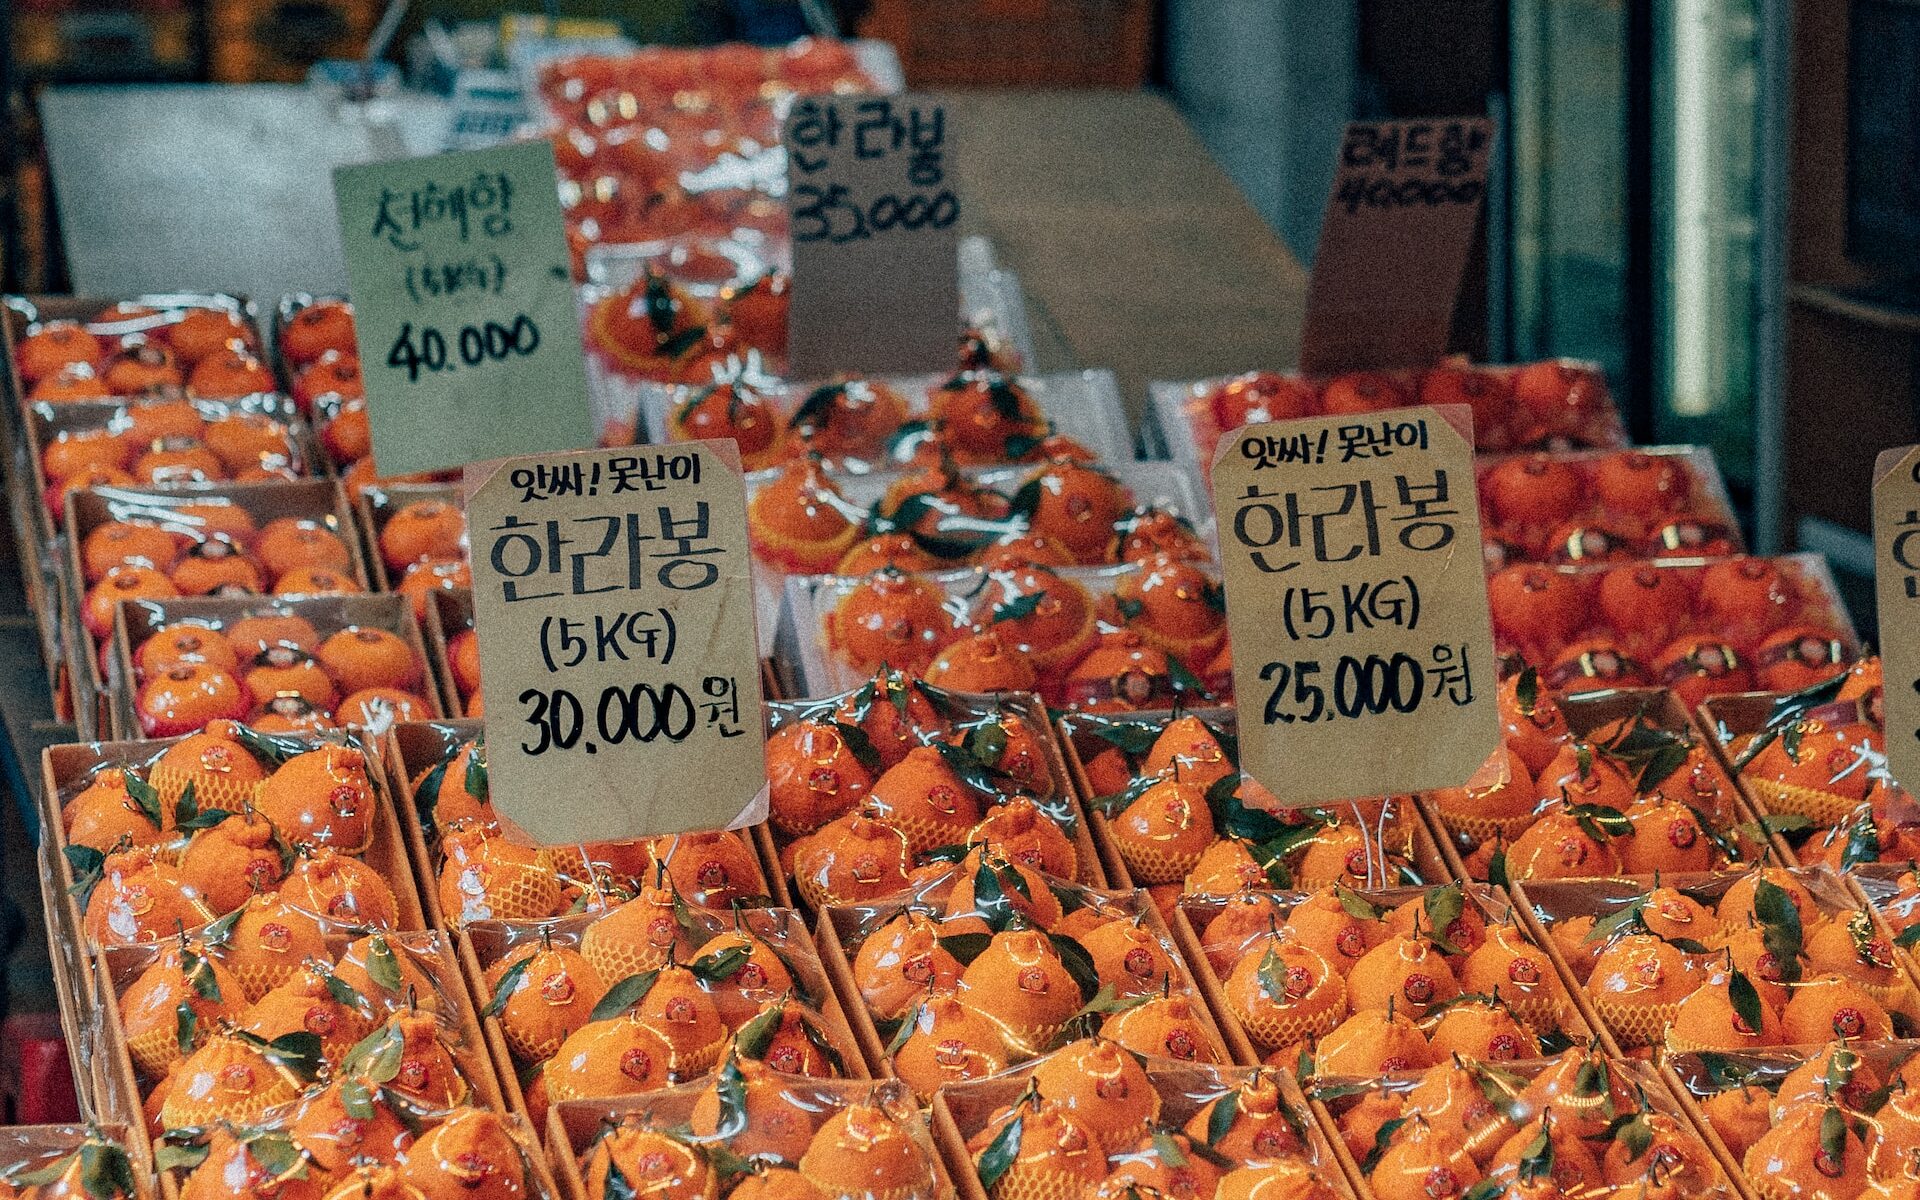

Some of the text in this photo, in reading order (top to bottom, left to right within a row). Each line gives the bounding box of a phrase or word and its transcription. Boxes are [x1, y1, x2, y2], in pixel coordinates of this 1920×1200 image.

[791, 101, 946, 187] 한라봉
[1343, 122, 1486, 177] 레드향
[510, 452, 701, 503] 앗싸! 못난이
[1241, 419, 1429, 471] 앗싸! 못난이
[489, 500, 727, 603] 한라봉
[1233, 469, 1459, 573] 한라봉
[539, 608, 677, 673] (5KG)
[1283, 575, 1420, 641] (5KG)
